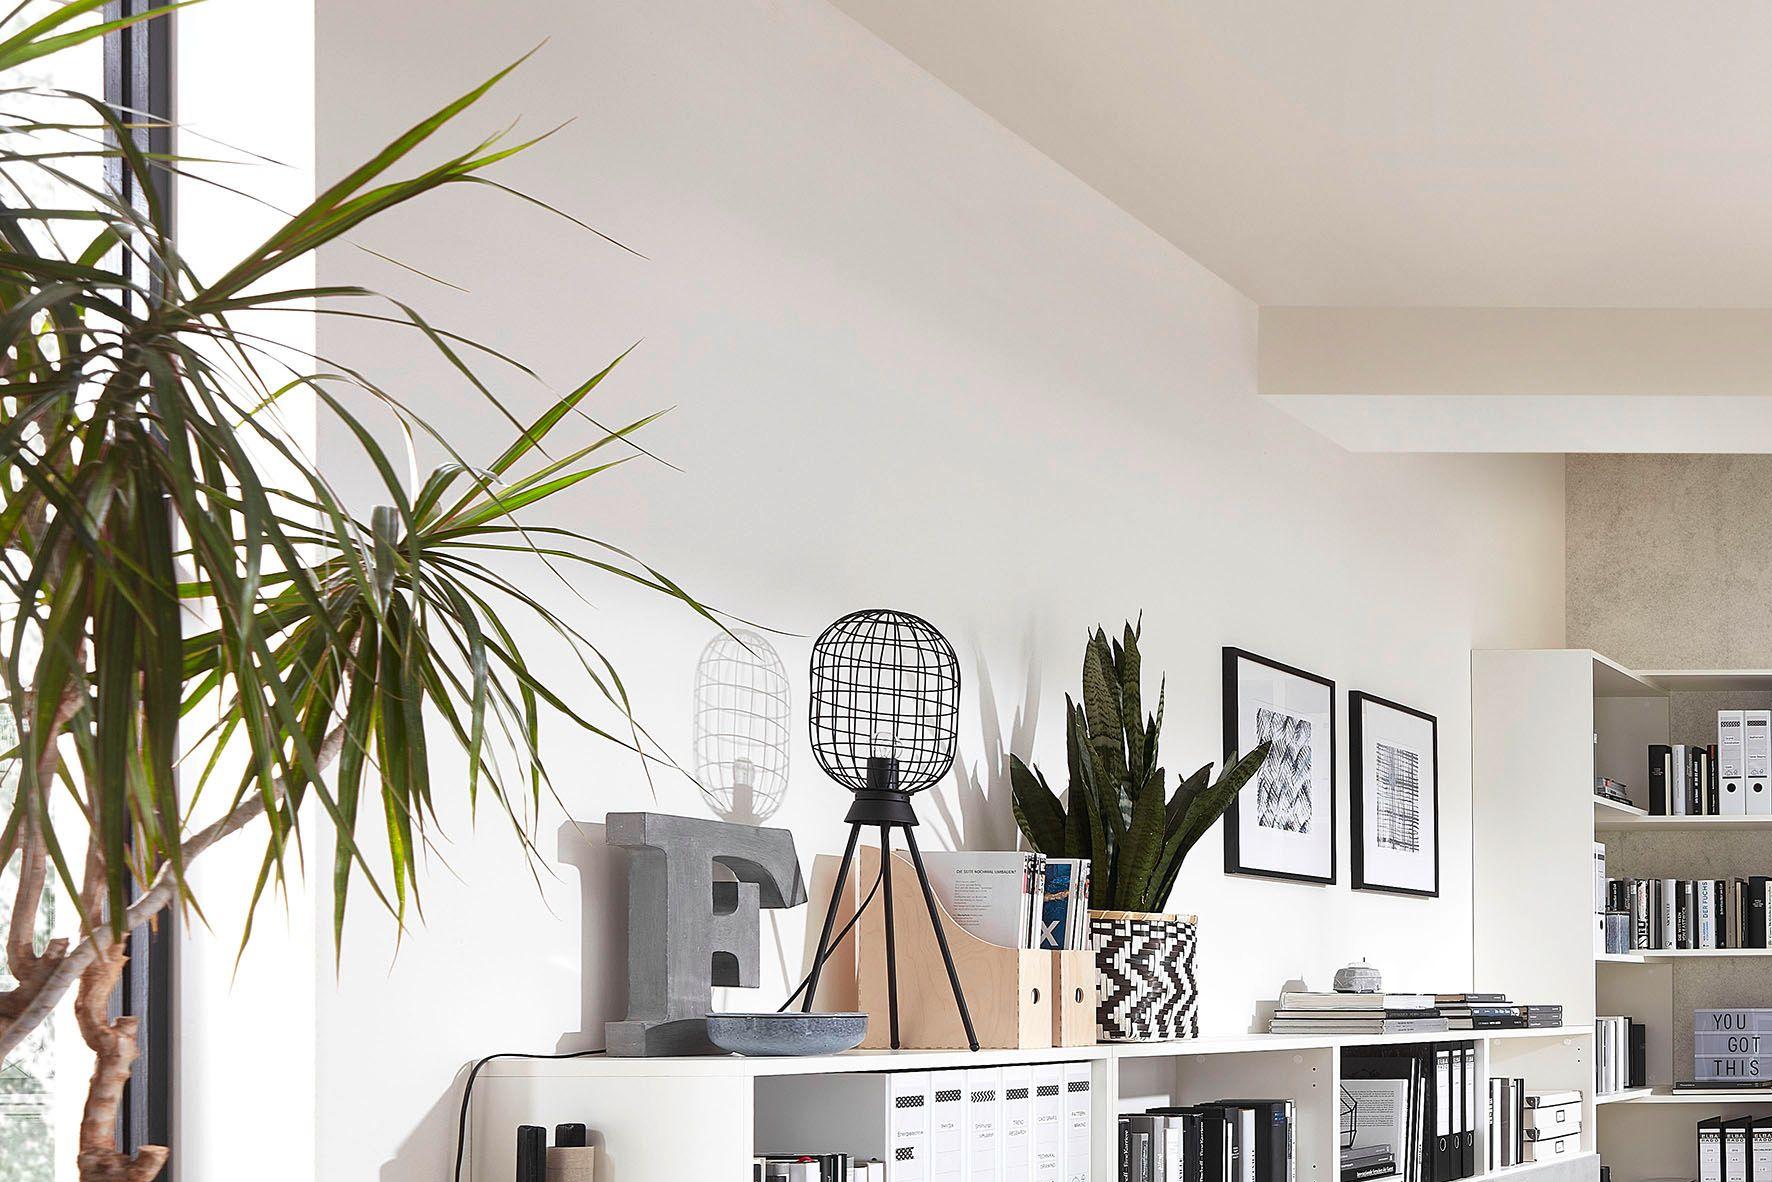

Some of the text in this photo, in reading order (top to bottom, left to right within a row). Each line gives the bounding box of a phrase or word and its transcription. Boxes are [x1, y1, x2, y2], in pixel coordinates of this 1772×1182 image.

[1713, 1014, 1746, 1030] YOU
[1728, 1036, 1760, 1053] GOT
[1714, 1060, 1759, 1076] THIS
